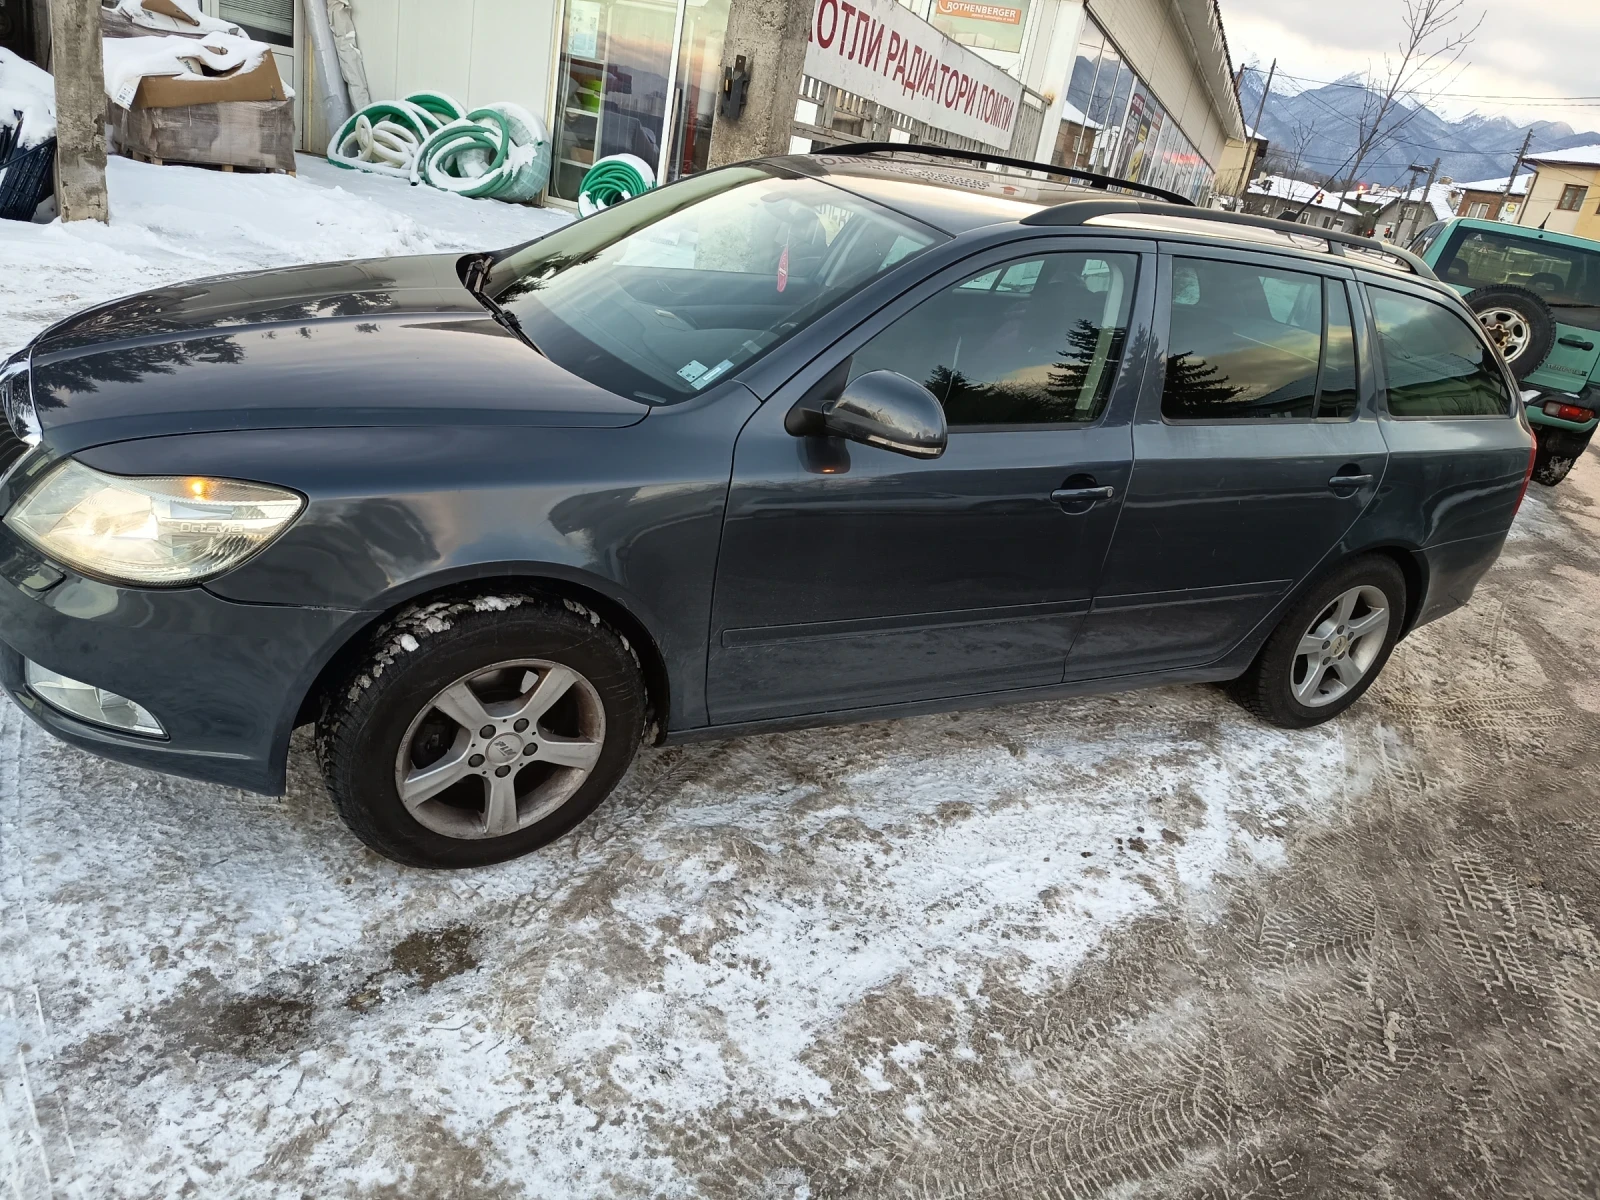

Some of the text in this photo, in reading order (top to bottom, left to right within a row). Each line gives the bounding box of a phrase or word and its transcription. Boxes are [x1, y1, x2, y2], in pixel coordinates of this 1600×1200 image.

[939, 1, 1016, 18] ROTHENBERGER
[808, 0, 1014, 132] ОТЛИ РАДИАТОРИ ПОМПИ
[180, 522, 244, 533] Octavia
